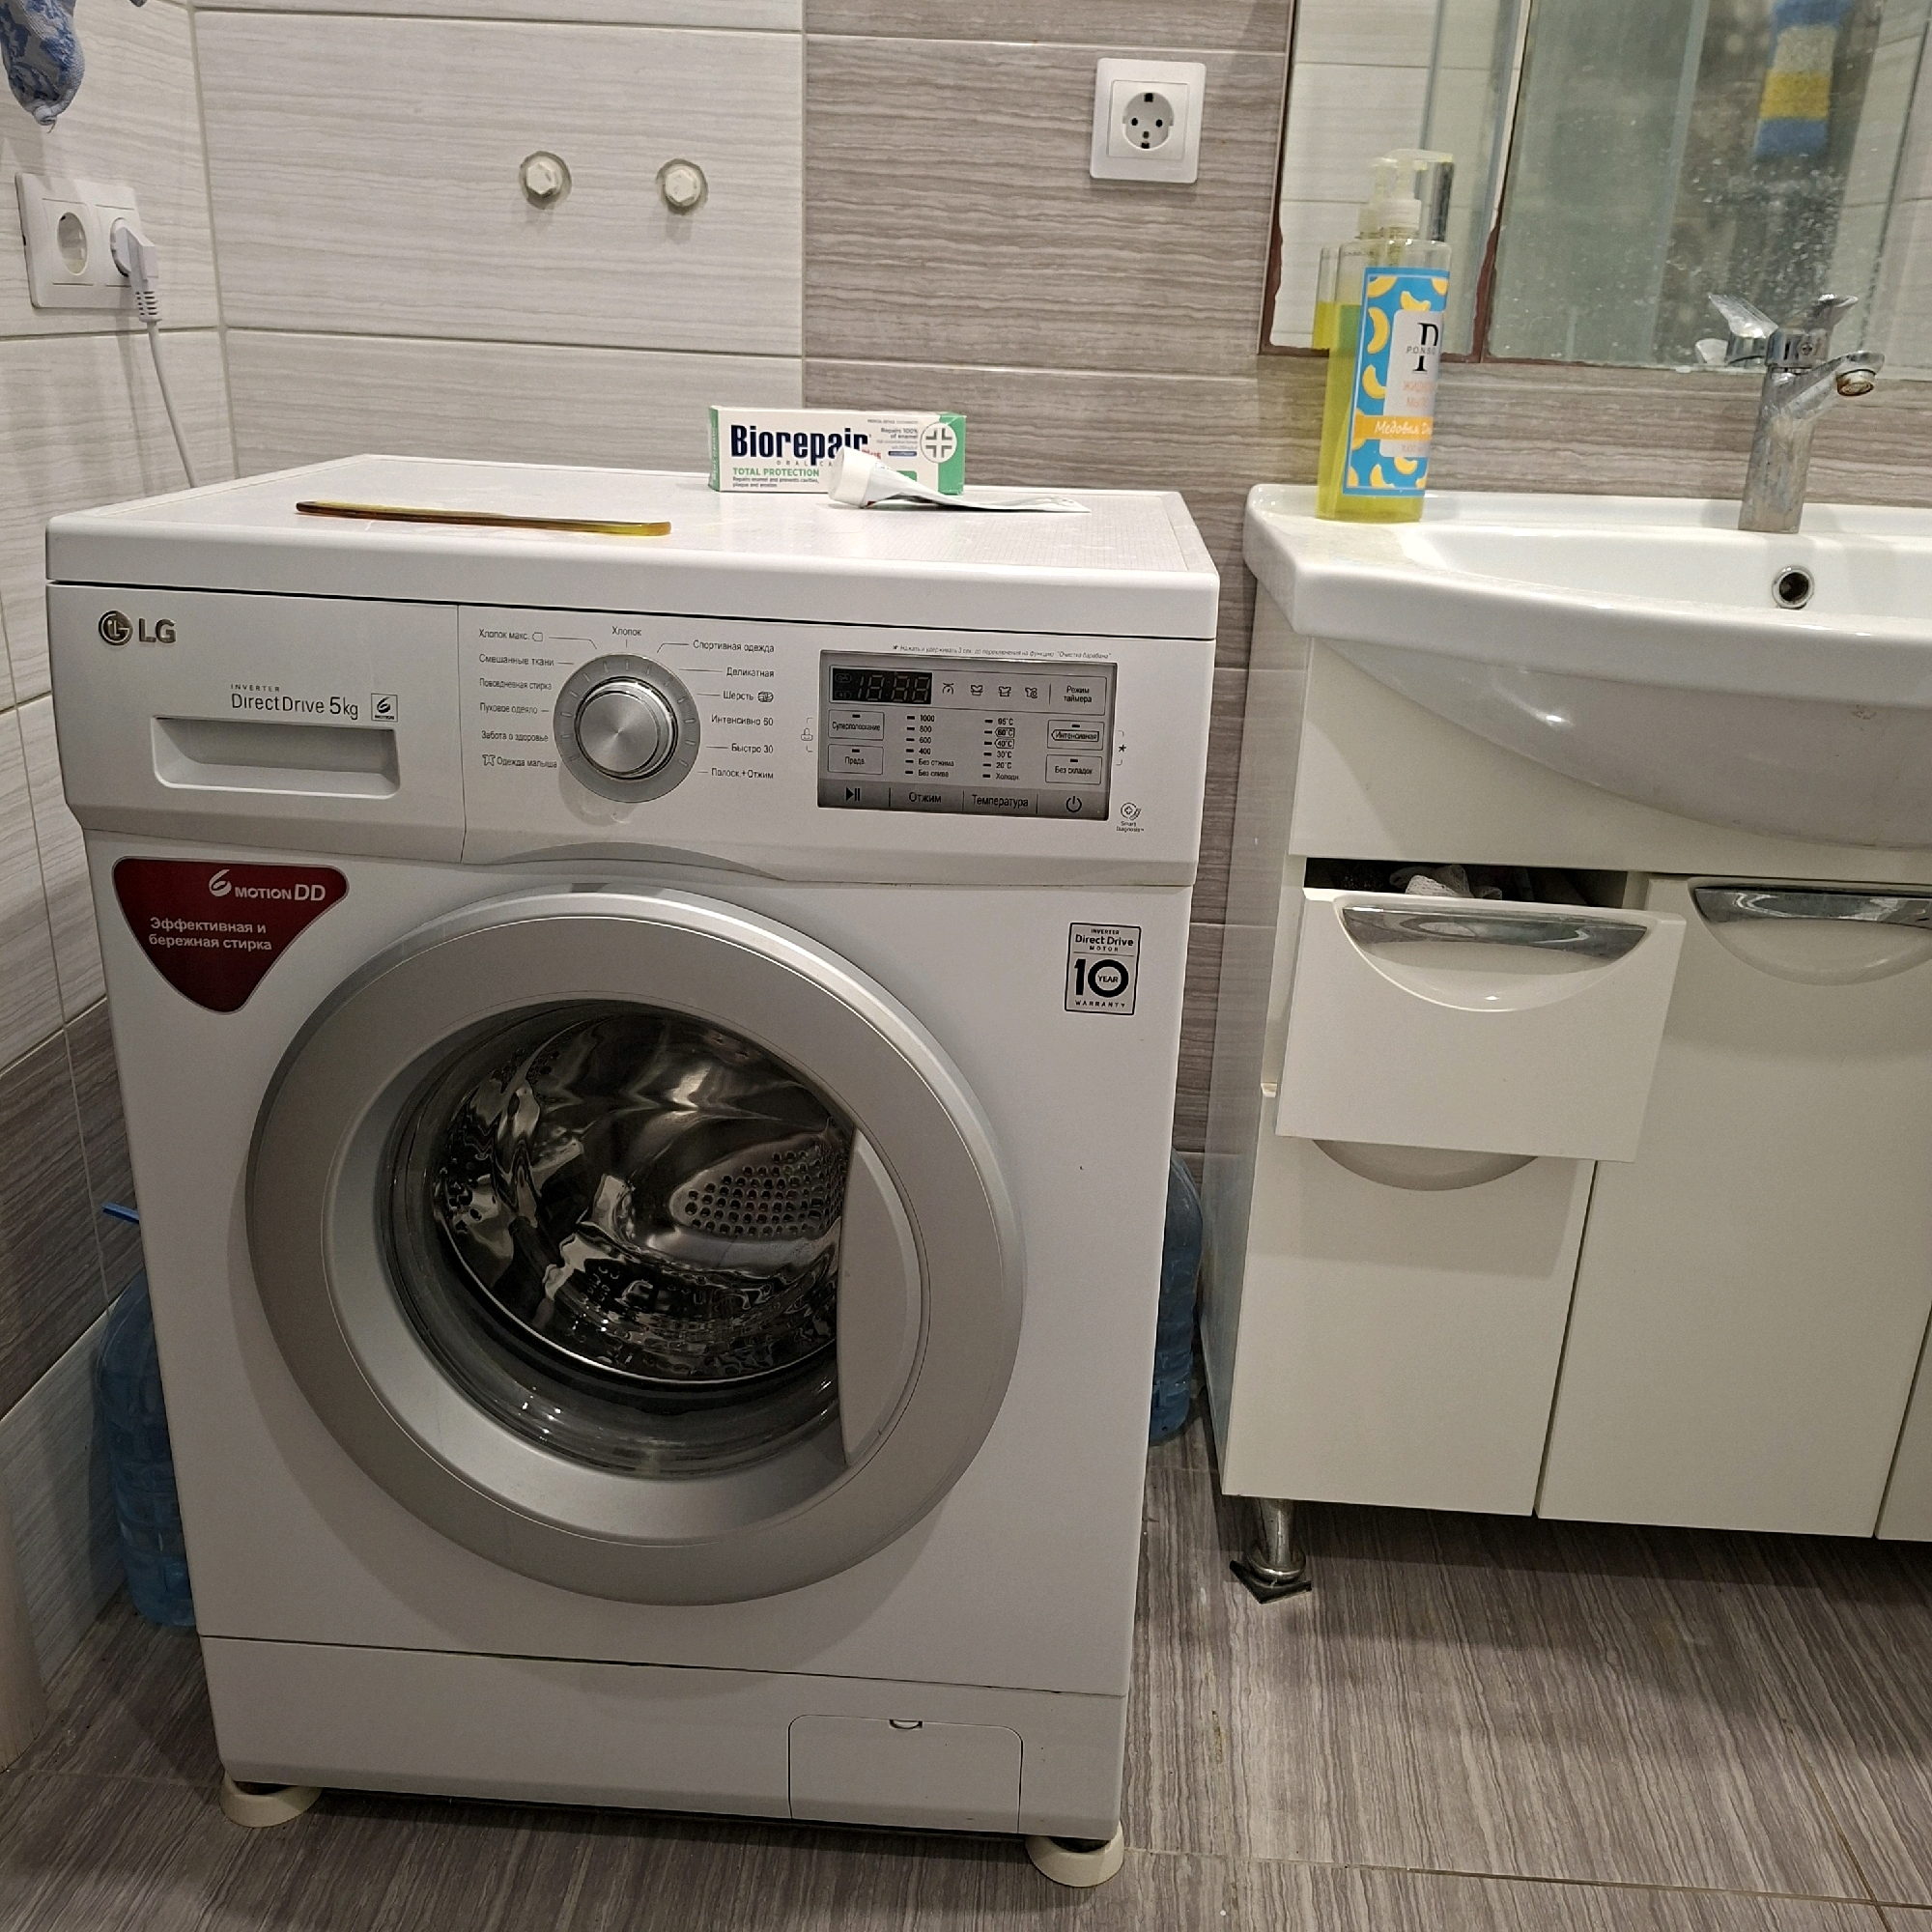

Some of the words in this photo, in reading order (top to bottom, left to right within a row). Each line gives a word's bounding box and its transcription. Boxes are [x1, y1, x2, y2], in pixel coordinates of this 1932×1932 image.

[731, 425, 868, 466] Biorepair
[733, 468, 761, 476] TOTAL
[764, 468, 819, 477] PROTECTION
[139, 618, 176, 643] LG
[479, 628, 506, 638] Хлопок
[509, 632, 530, 640] макс.
[611, 625, 642, 636] Хлопок
[693, 639, 741, 651] Спортивная
[744, 644, 774, 653] одежда
[479, 653, 529, 665] Смешанные
[726, 667, 774, 677] Деликатная
[231, 683, 280, 692] INVERTER
[529, 682, 552, 692] стирка
[1066, 685, 1090, 694] Режим
[723, 690, 754, 701] Шерсть
[1064, 695, 1092, 704] таймера
[480, 702, 510, 713] Пуховое
[511, 706, 538, 714] одеяло
[711, 714, 761, 725] Интенсивно
[482, 730, 506, 740] Забота
[515, 734, 548, 743] здоровье
[731, 743, 761, 754] Быстро
[764, 744, 773, 753] 30
[497, 757, 525, 767] Одежда
[527, 760, 557, 768] малыша
[909, 792, 941, 803] Отжим
[972, 794, 1029, 809] Температура
[234, 886, 292, 900] MOTION
[294, 883, 326, 901] DD
[150, 917, 253, 933] Эффективная
[257, 924, 266, 933] и
[148, 934, 220, 948] бережная
[223, 939, 272, 952] стирка
[1075, 934, 1105, 944] Direct
[1107, 936, 1134, 946] Drive
[1074, 959, 1129, 998] 10
[1098, 975, 1118, 983] YEAR
[1075, 1000, 1125, 1008] WARRANTY
